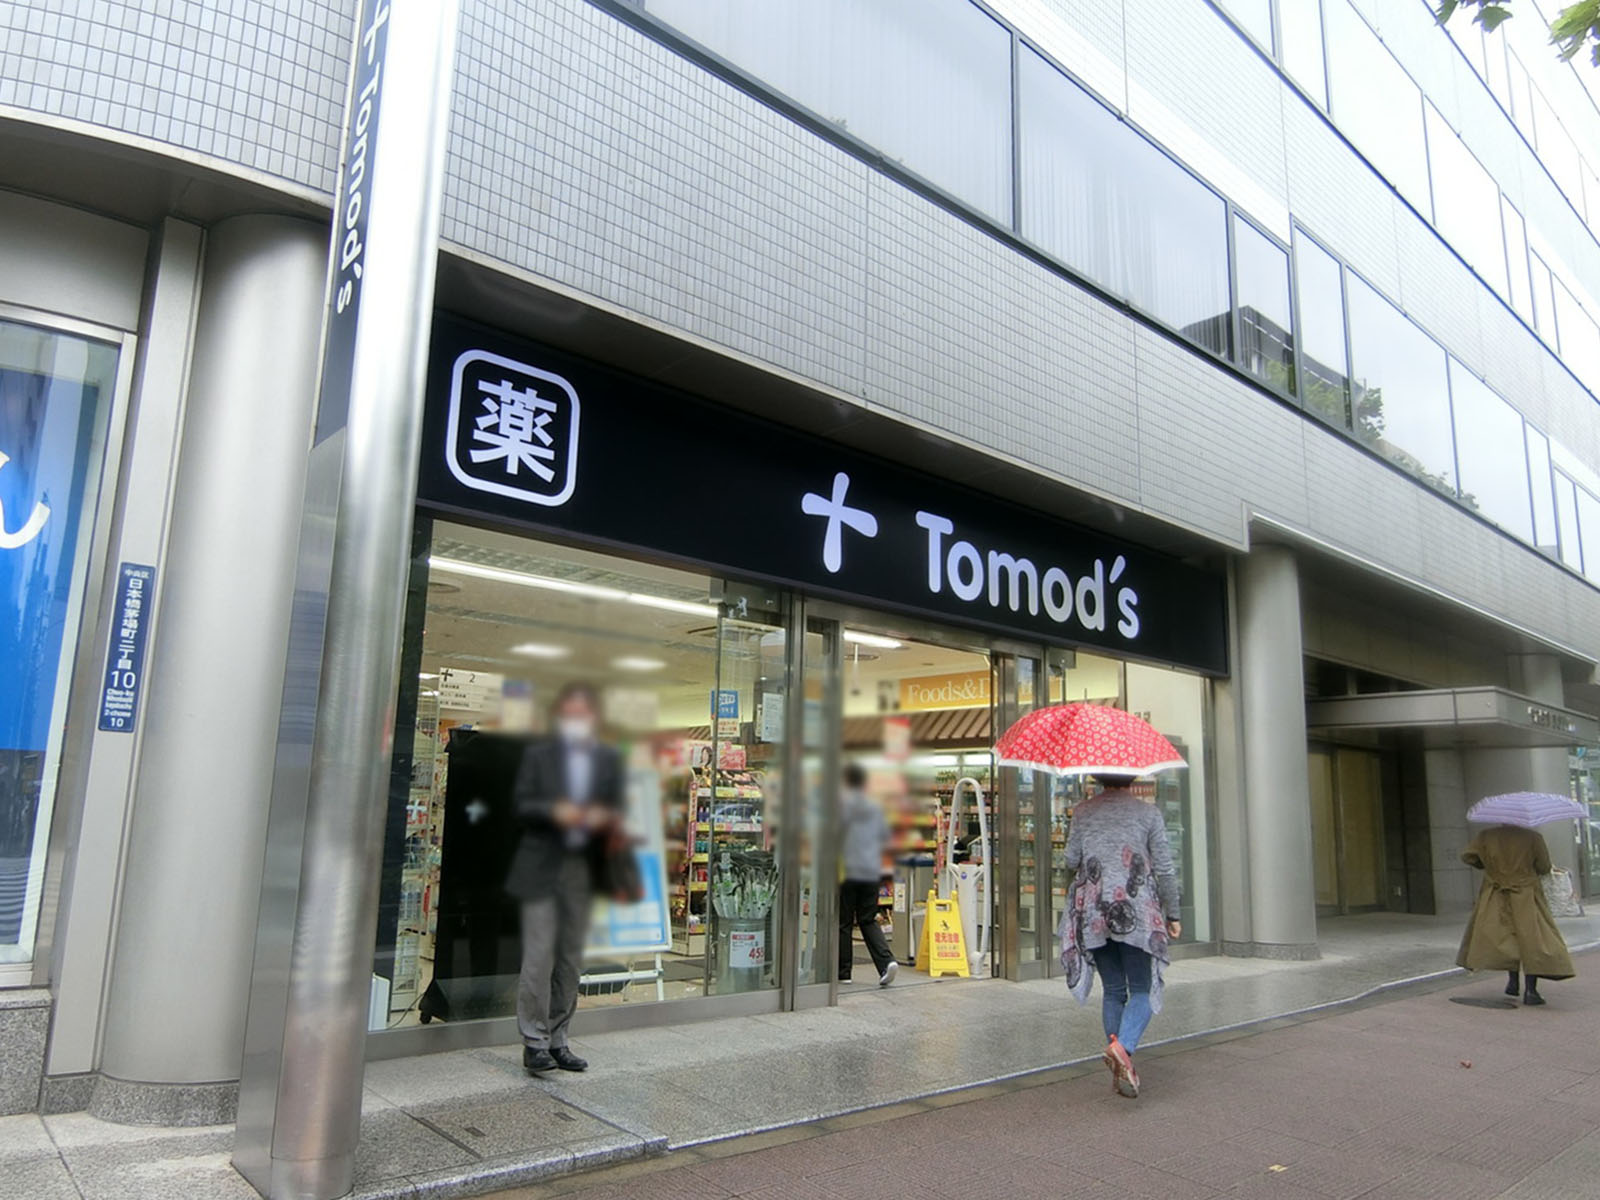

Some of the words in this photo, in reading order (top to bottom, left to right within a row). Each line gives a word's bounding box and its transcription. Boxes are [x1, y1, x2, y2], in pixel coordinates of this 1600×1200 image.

[337, 61, 380, 314] Tomod's
[469, 379, 557, 483] 薬
[915, 510, 1140, 639] Tomod's
[111, 670, 136, 689] 10
[111, 717, 124, 727] 10
